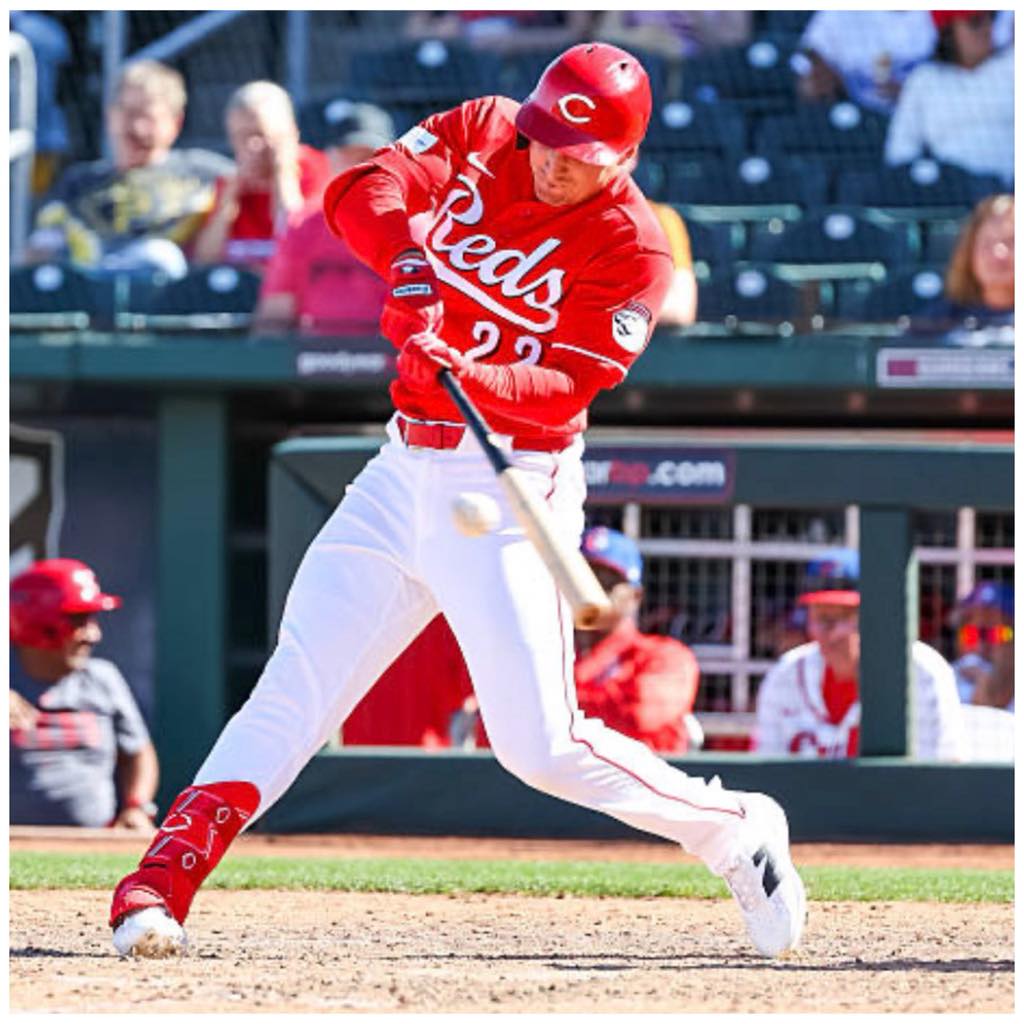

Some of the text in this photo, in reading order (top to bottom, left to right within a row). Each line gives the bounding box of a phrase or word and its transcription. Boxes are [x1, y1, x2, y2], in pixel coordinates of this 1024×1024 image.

[557, 92, 597, 124] C
[426, 173, 566, 333] Reds
[463, 320, 542, 367] 22
